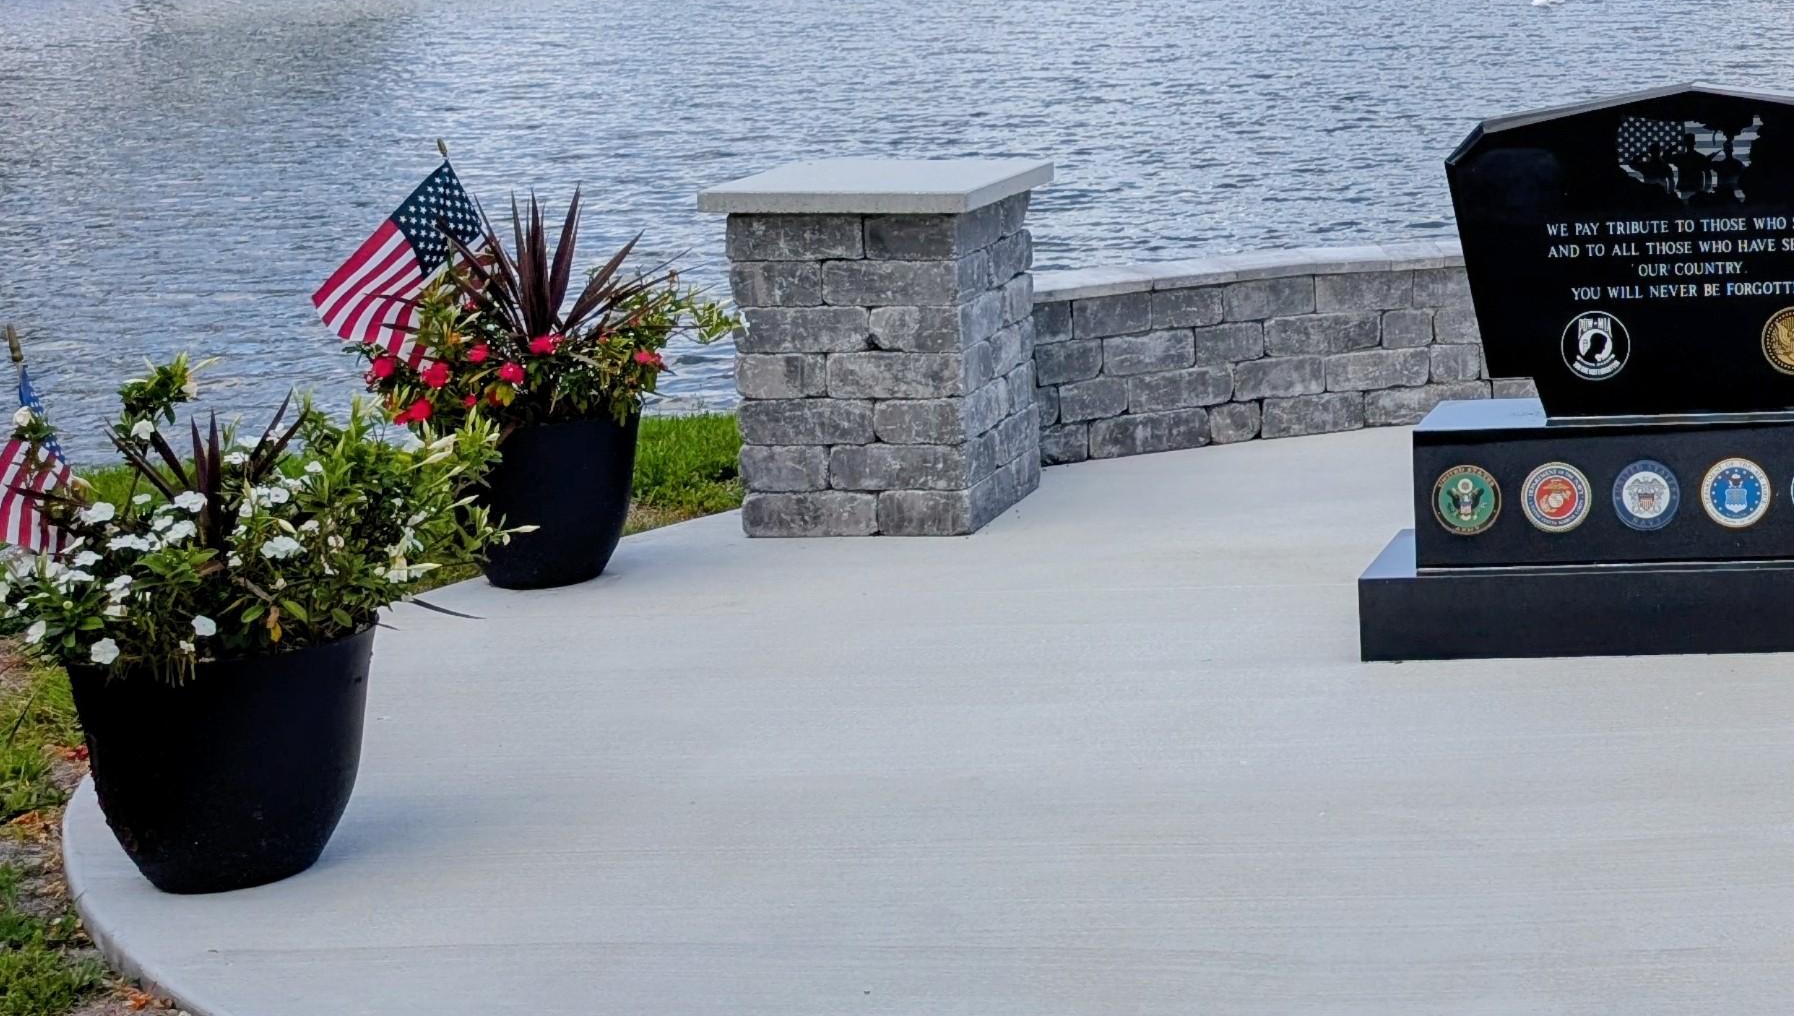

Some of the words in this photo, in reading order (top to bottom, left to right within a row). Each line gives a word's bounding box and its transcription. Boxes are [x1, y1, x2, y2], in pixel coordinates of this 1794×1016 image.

[1546, 223, 1569, 237] WE
[1574, 222, 1600, 236] PAY
[1606, 220, 1669, 235] TRIBUTE
[1675, 219, 1695, 233] TO
[1700, 218, 1747, 232] THOSE
[1753, 216, 1787, 231] WHO
[1547, 244, 1580, 259] AND
[1586, 243, 1605, 257] TO
[1611, 242, 1640, 256] ALL
[1646, 241, 1693, 255] THOSE
[1699, 240, 1733, 253] WHO
[1738, 238, 1777, 253] HAVE
[1571, 286, 1601, 301] YOU
[1607, 285, 1644, 300] WILL
[1650, 283, 1698, 298] NEVER
[1703, 282, 1721, 297] BE
